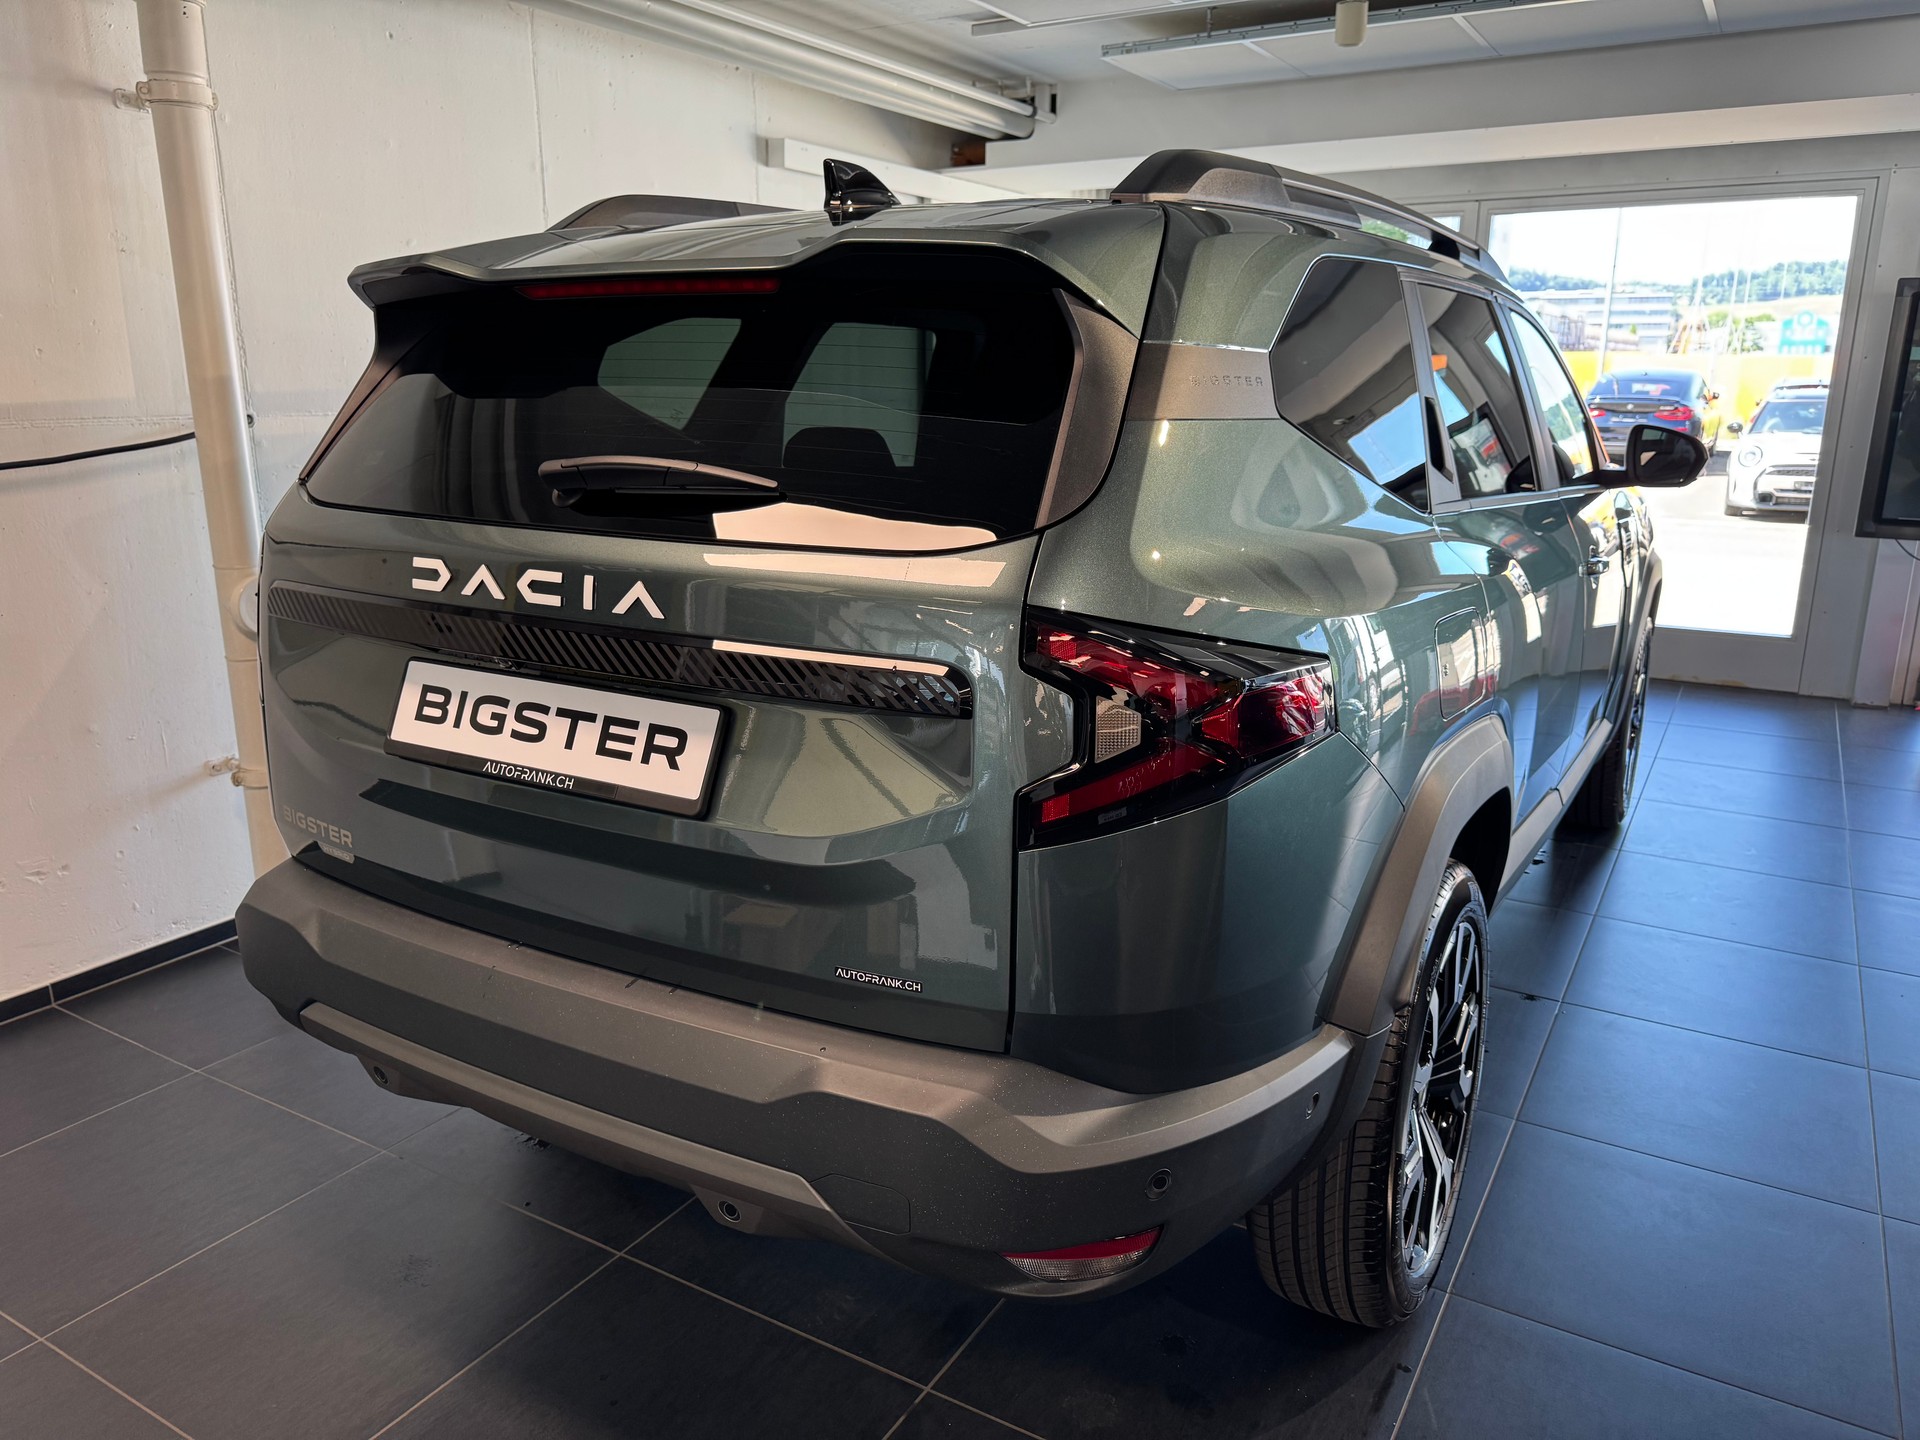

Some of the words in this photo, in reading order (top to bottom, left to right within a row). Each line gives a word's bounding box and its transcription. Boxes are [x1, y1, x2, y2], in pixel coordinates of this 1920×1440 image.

[412, 556, 665, 619] DACIA
[413, 684, 689, 771] BIGSTER
[482, 761, 574, 790] AUTOFRANK.CH
[284, 804, 353, 848] BIGSTER
[835, 968, 921, 992] AUTOFRANK.CH
